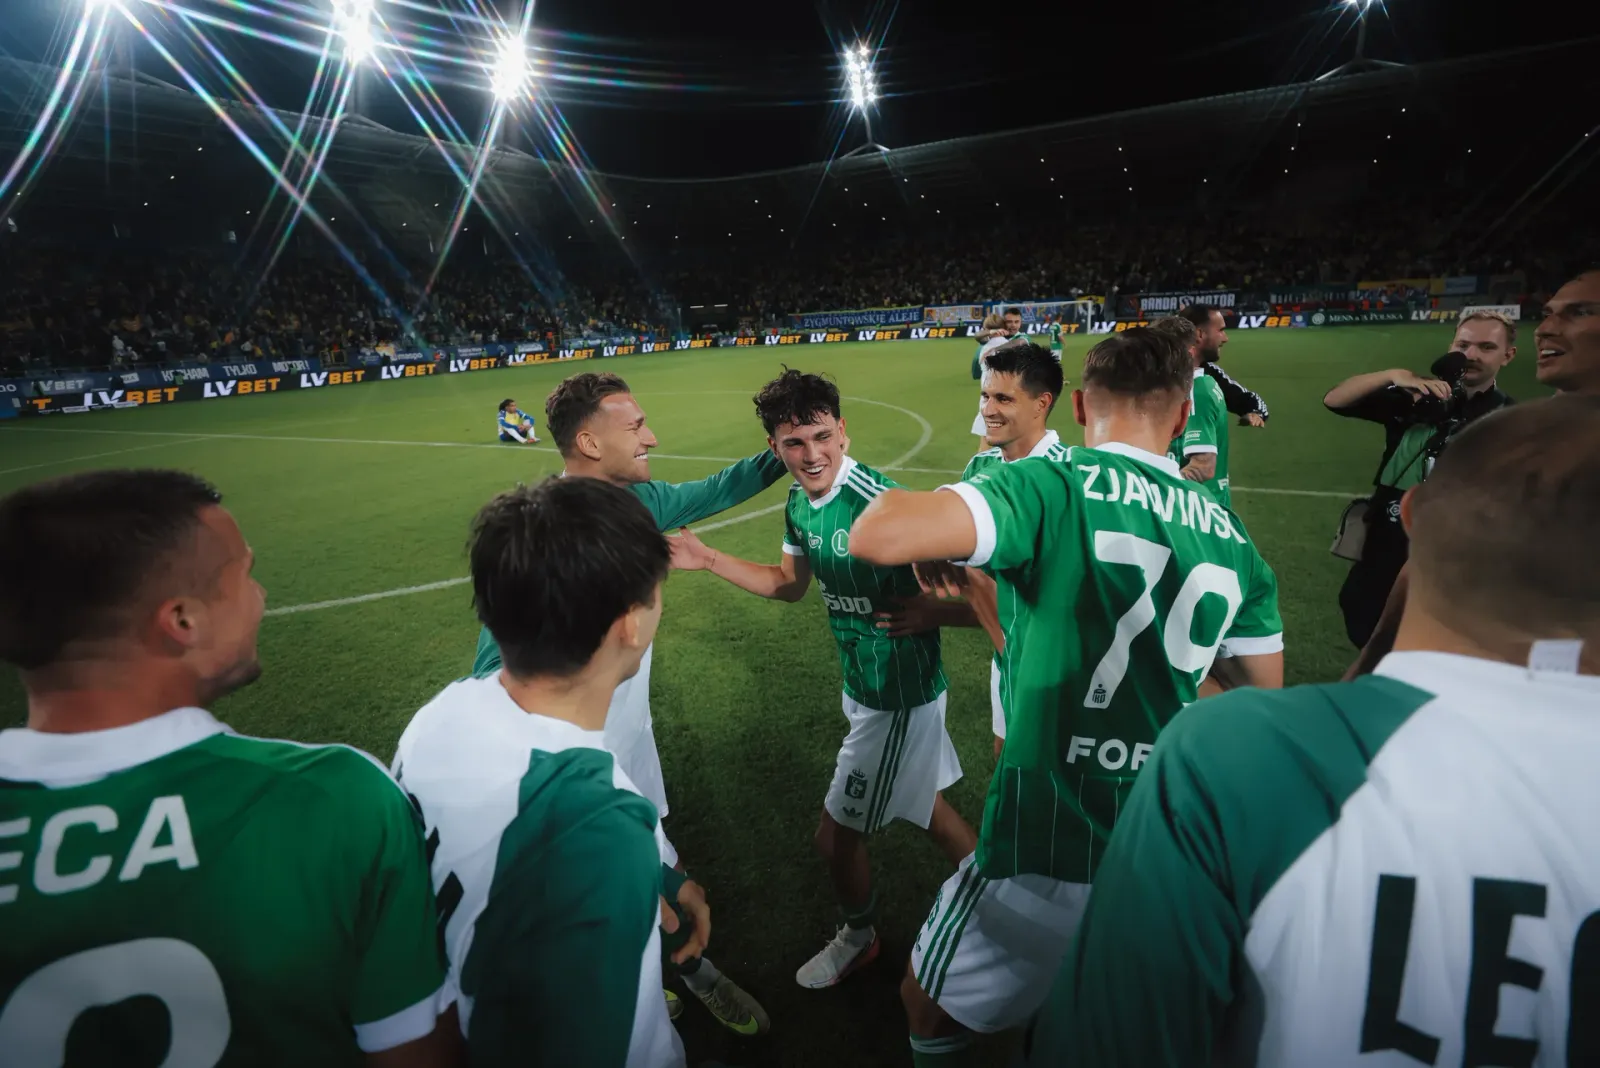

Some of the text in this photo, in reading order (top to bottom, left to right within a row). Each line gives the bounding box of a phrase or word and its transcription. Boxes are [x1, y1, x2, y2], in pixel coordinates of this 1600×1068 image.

[1140, 293, 1235, 311] BANDA MOTOR
[888, 311, 920, 323] ALEJE
[1329, 311, 1404, 322] MENNA POLSKA
[1026, 323, 1079, 334] LVET
[161, 367, 209, 382] KHAM
[222, 363, 257, 377] TYLKO
[1083, 529, 1243, 710] 79
